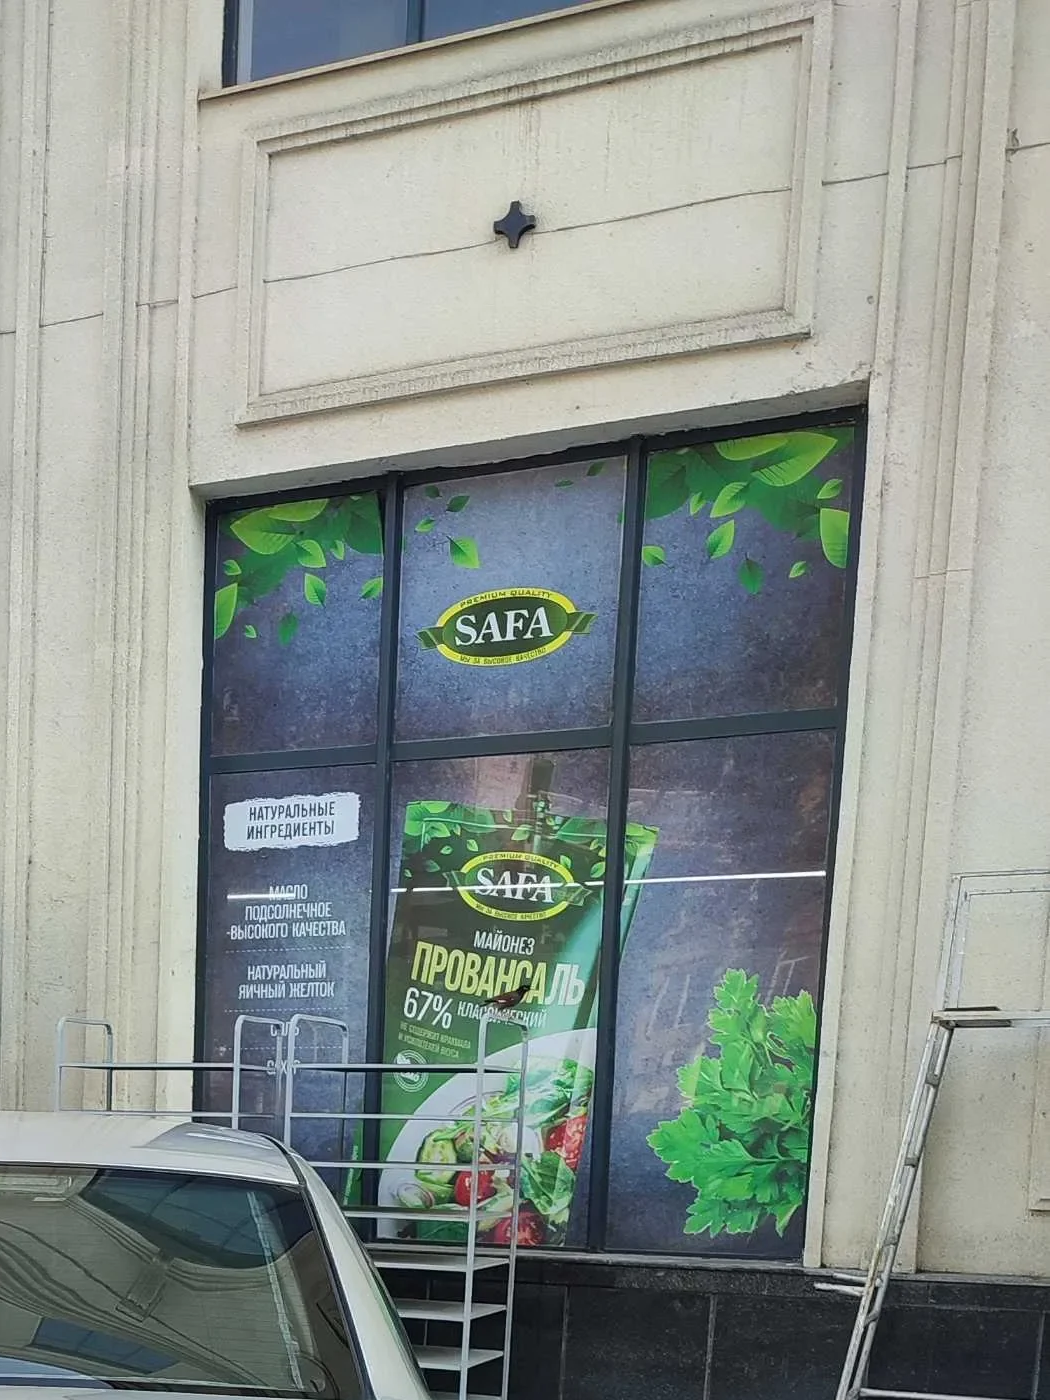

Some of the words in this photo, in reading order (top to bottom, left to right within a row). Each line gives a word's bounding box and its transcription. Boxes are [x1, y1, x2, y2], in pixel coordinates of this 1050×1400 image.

[459, 591, 506, 608] PREMIUM
[510, 590, 552, 600] QUALITY
[454, 606, 554, 646] SAFA
[249, 801, 336, 821] НАТУРАЛЬНЫЕ
[246, 820, 335, 840] ИНГРЕДИЕНТЫ
[269, 884, 308, 901] МАСЛО
[475, 867, 555, 904] SAFA
[245, 902, 333, 923] ПОДСОЛНЕЧНОЕ
[292, 920, 347, 938] КАЧЕСТВА
[473, 930, 536, 956] МАЙОНЕЗ
[247, 960, 327, 981] НАТУРАЛЬНЫЙ
[411, 940, 586, 1006] ПРОВАНСАЛЬ
[238, 981, 286, 1000] ЯИЧНЫЙ
[289, 981, 335, 998] ЖЕЛТОК
[403, 986, 454, 1030] 67%
